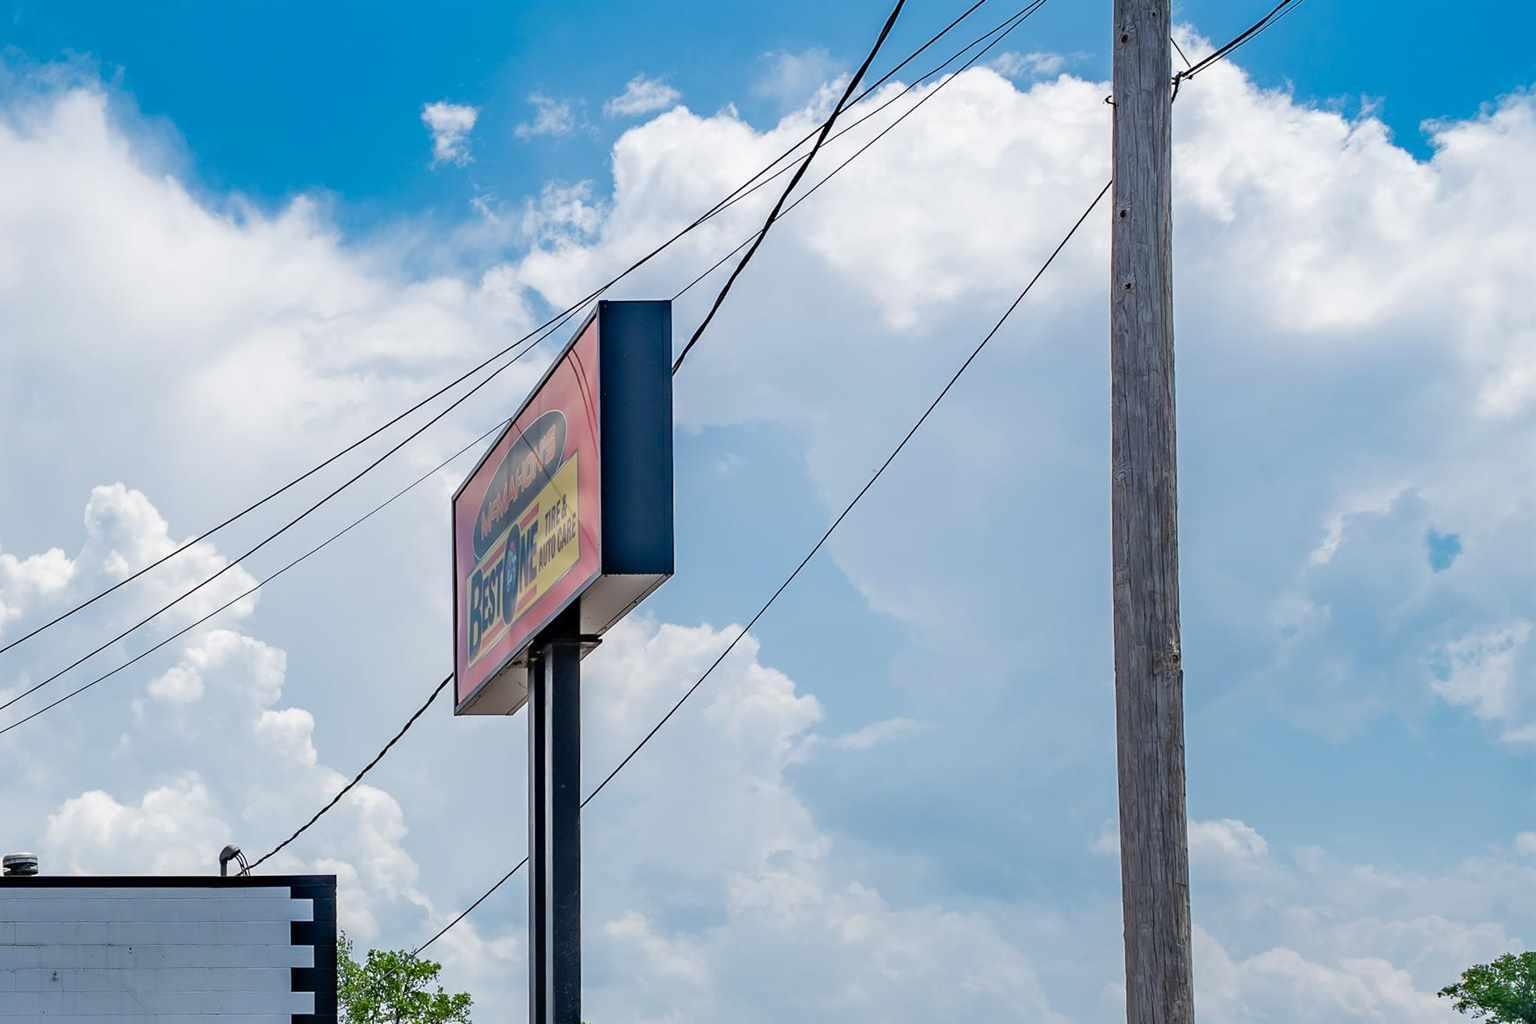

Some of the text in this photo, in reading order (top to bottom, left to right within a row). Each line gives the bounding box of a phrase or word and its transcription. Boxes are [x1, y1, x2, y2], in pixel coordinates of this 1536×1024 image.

[544, 493, 568, 536] TIRE &
[538, 512, 576, 572] AUTO CARE
